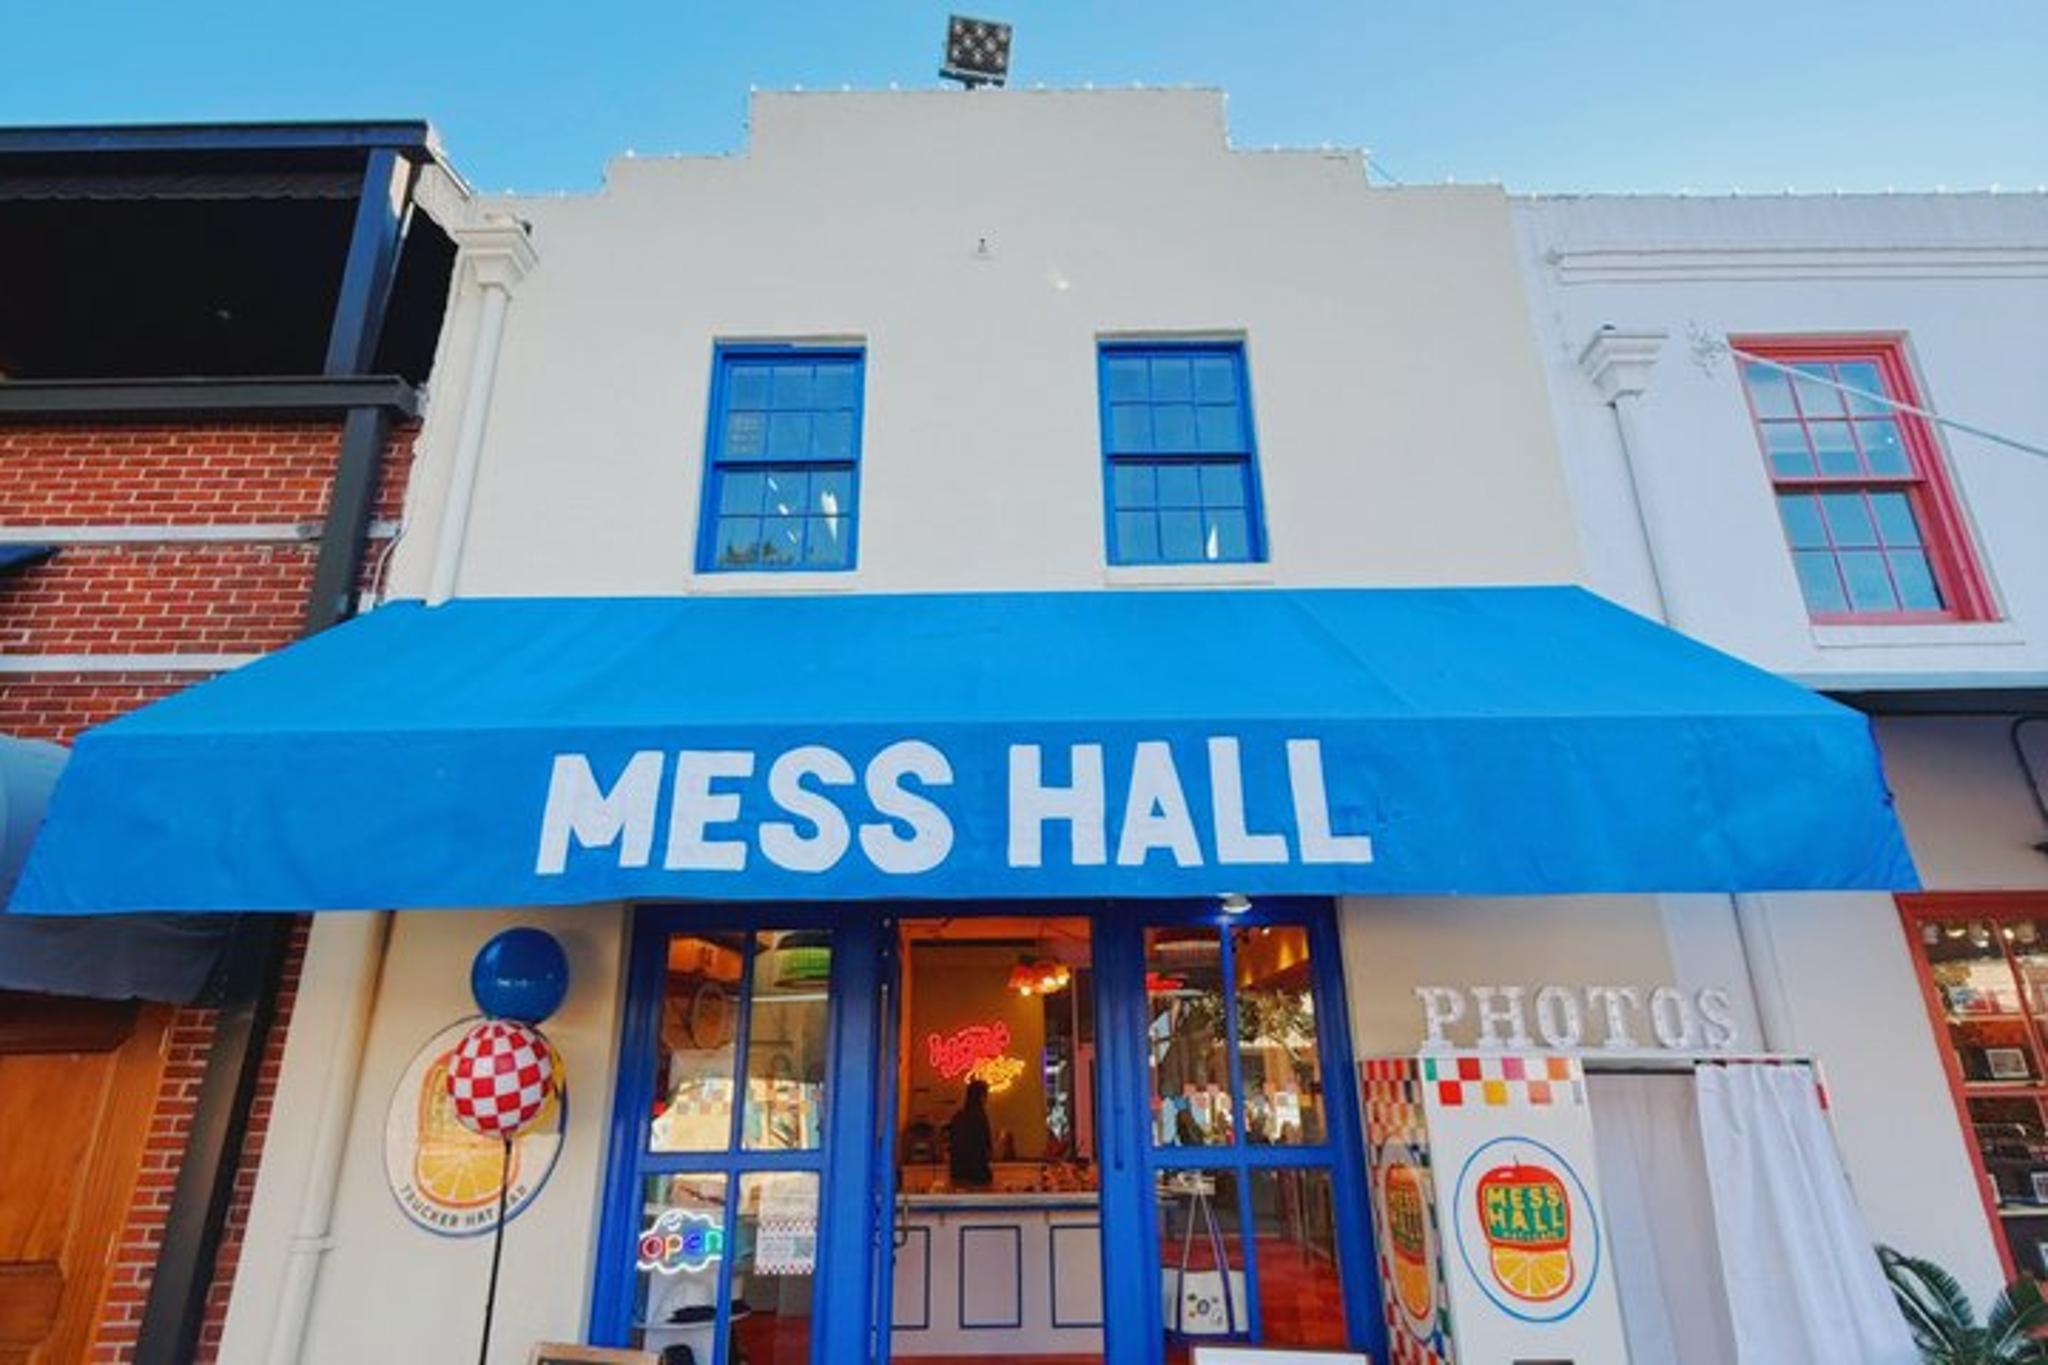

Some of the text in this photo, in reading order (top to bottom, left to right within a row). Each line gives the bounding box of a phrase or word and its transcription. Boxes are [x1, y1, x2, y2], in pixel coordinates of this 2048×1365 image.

[535, 736, 1374, 875] MESS HALL
[1413, 985, 1737, 1050] PHOTOS
[399, 1183, 459, 1227] TRUCKER
[465, 1207, 494, 1225] HAT
[1486, 1183, 1560, 1209] MESS
[1489, 1204, 1564, 1231] HALL
[642, 1230, 723, 1262] open
